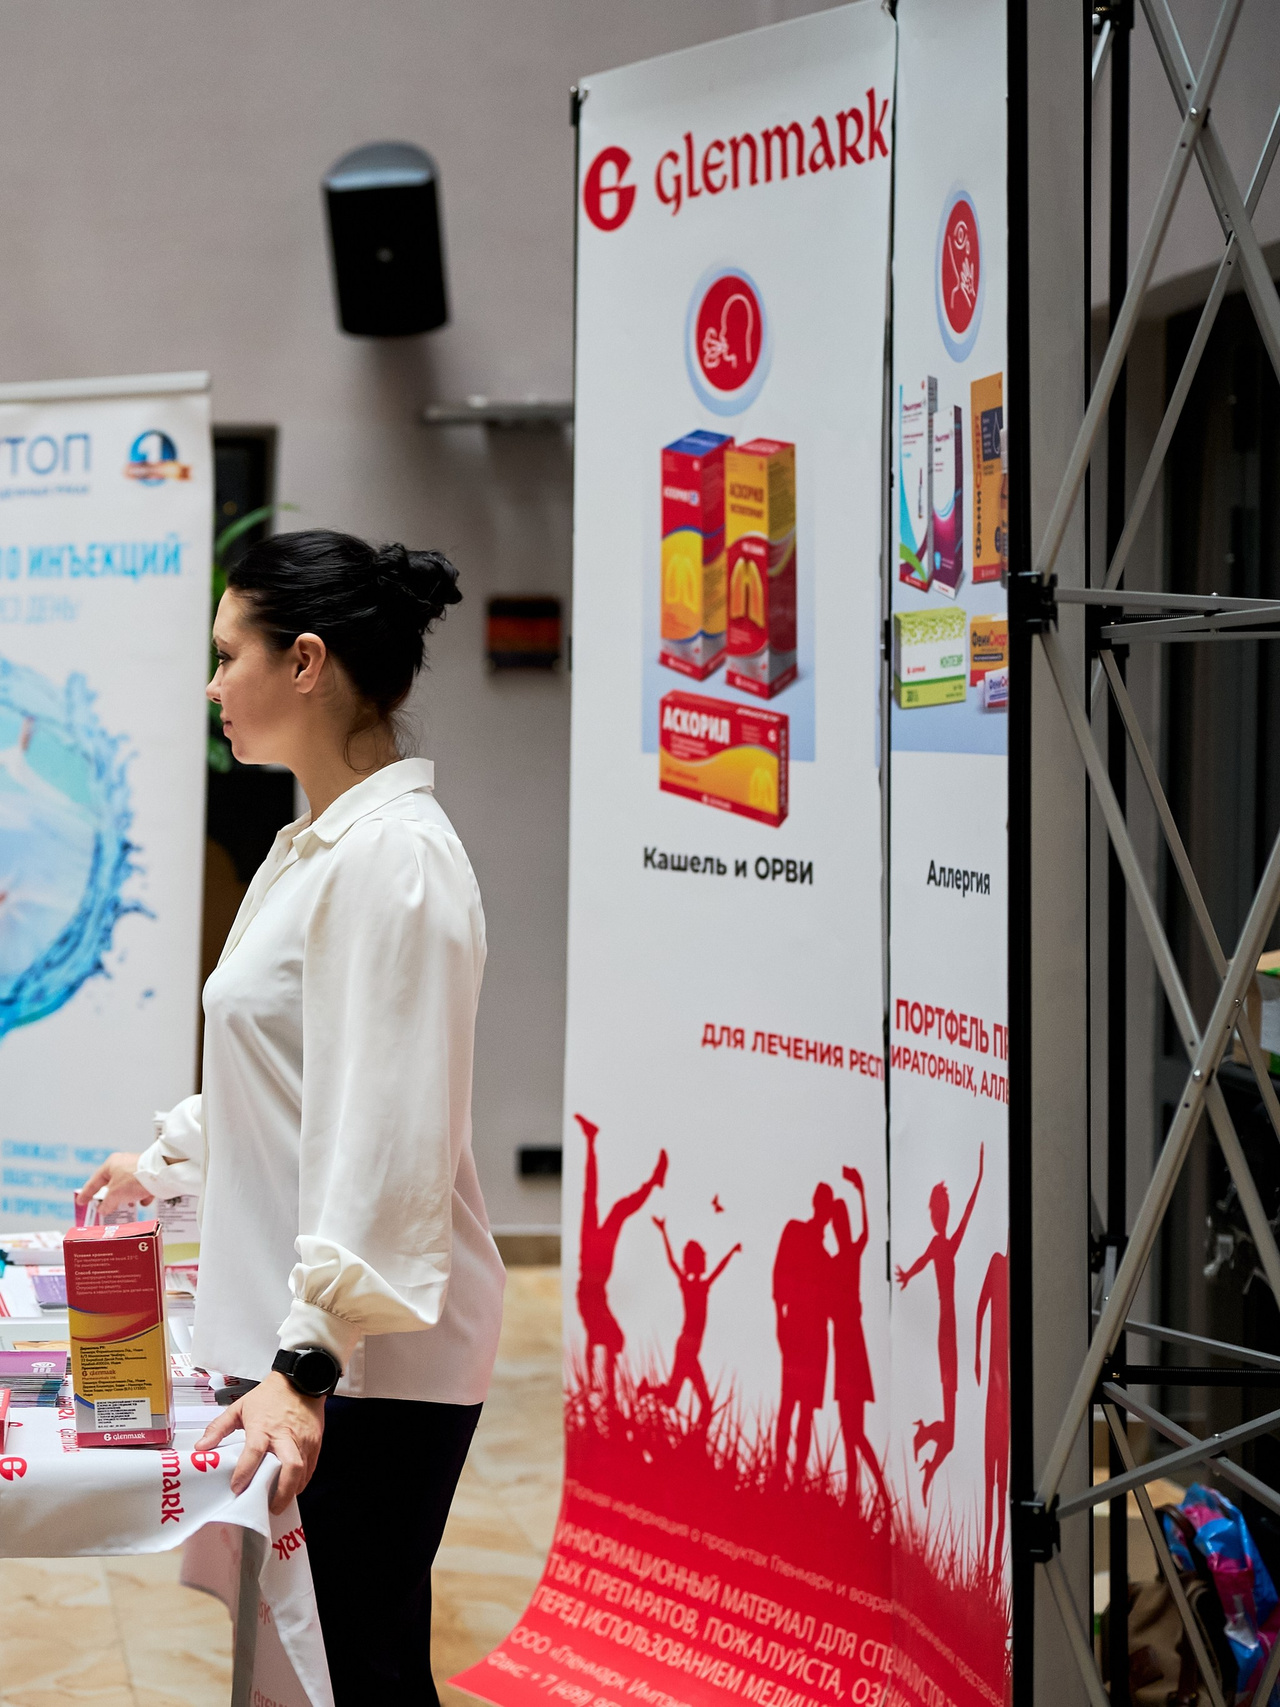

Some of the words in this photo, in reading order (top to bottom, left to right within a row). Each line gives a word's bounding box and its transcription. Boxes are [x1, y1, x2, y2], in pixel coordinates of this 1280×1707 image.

[27, 532, 183, 585] ИНЪЕКЦИЙ
[662, 705, 731, 745] АСКОРИЛ
[643, 847, 727, 877] Кашель
[734, 859, 747, 878] и
[754, 856, 814, 886] ОРВИ
[926, 860, 991, 898] Аллергия
[701, 1022, 745, 1050] ДЛЯ
[751, 1030, 844, 1069] ЛЕЧЕНИЯ
[895, 998, 990, 1054] ПОРТФЕЛЬ
[555, 1519, 721, 1606] ИНФОРМАЦИОННЫЙ
[720, 1583, 816, 1643] МАТЕРИАЛ
[815, 1622, 858, 1660] ДЛЯ
[510, 1626, 552, 1655] ООО
[532, 1585, 586, 1629] ПЕРЕД
[581, 1605, 745, 1694] ИСПОЛЬЗОВАНИЕМ
[546, 1552, 586, 1590] ТЫХ
[583, 1567, 700, 1640] ПРЕПАРАТОВ,
[702, 1616, 845, 1701] ПОЖАЛУЙСТА,
